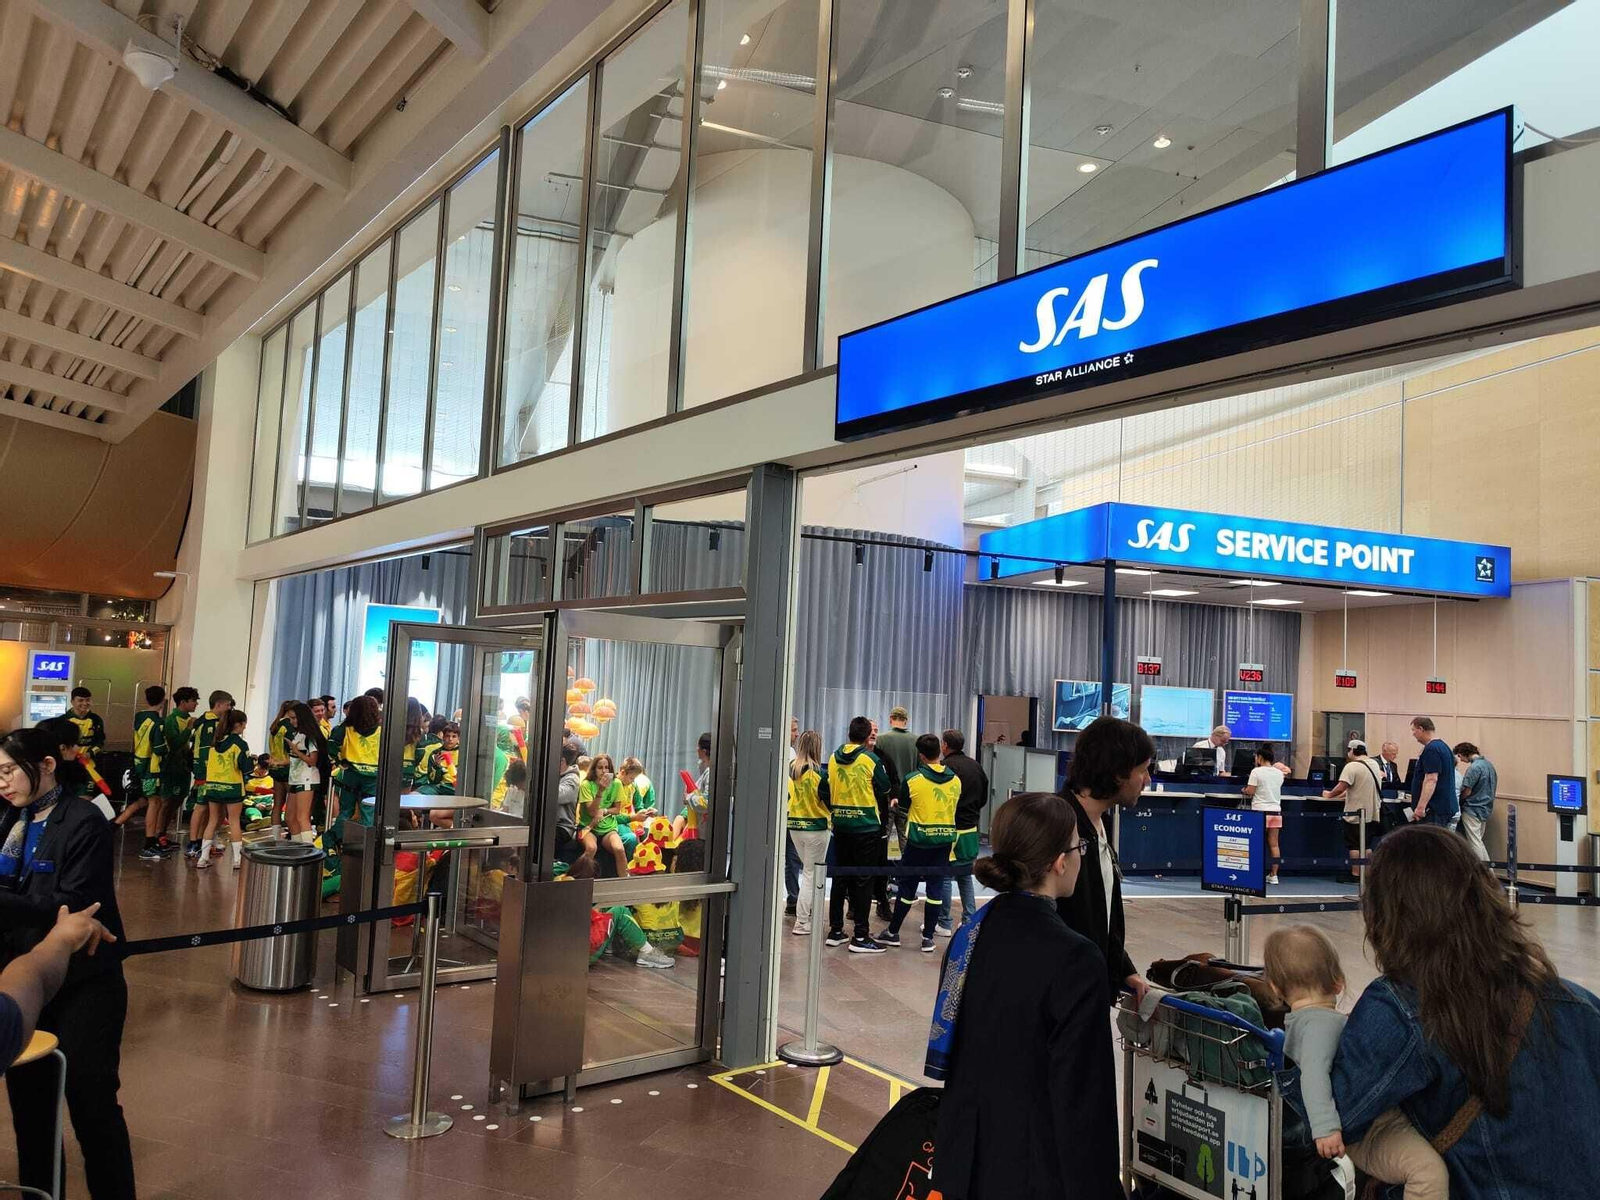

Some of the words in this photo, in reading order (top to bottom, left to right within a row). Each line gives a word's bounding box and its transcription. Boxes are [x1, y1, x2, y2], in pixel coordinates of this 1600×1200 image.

[1018, 258, 1159, 353] SAS
[1035, 370, 1063, 385] STAR
[1065, 356, 1121, 379] ALLIANCE
[1127, 518, 1196, 553] SAS
[1216, 529, 1328, 566] SERVICE
[1336, 541, 1415, 574] POINT
[37, 660, 65, 672] SAS
[1223, 813, 1243, 822] SAS
[1213, 824, 1253, 835] ECONOMY
[1171, 1098, 1194, 1112] Nyheter
[1194, 1109, 1205, 1117] och
[1171, 1107, 1206, 1124] erbjudanden
[1171, 1121, 1182, 1129] och
